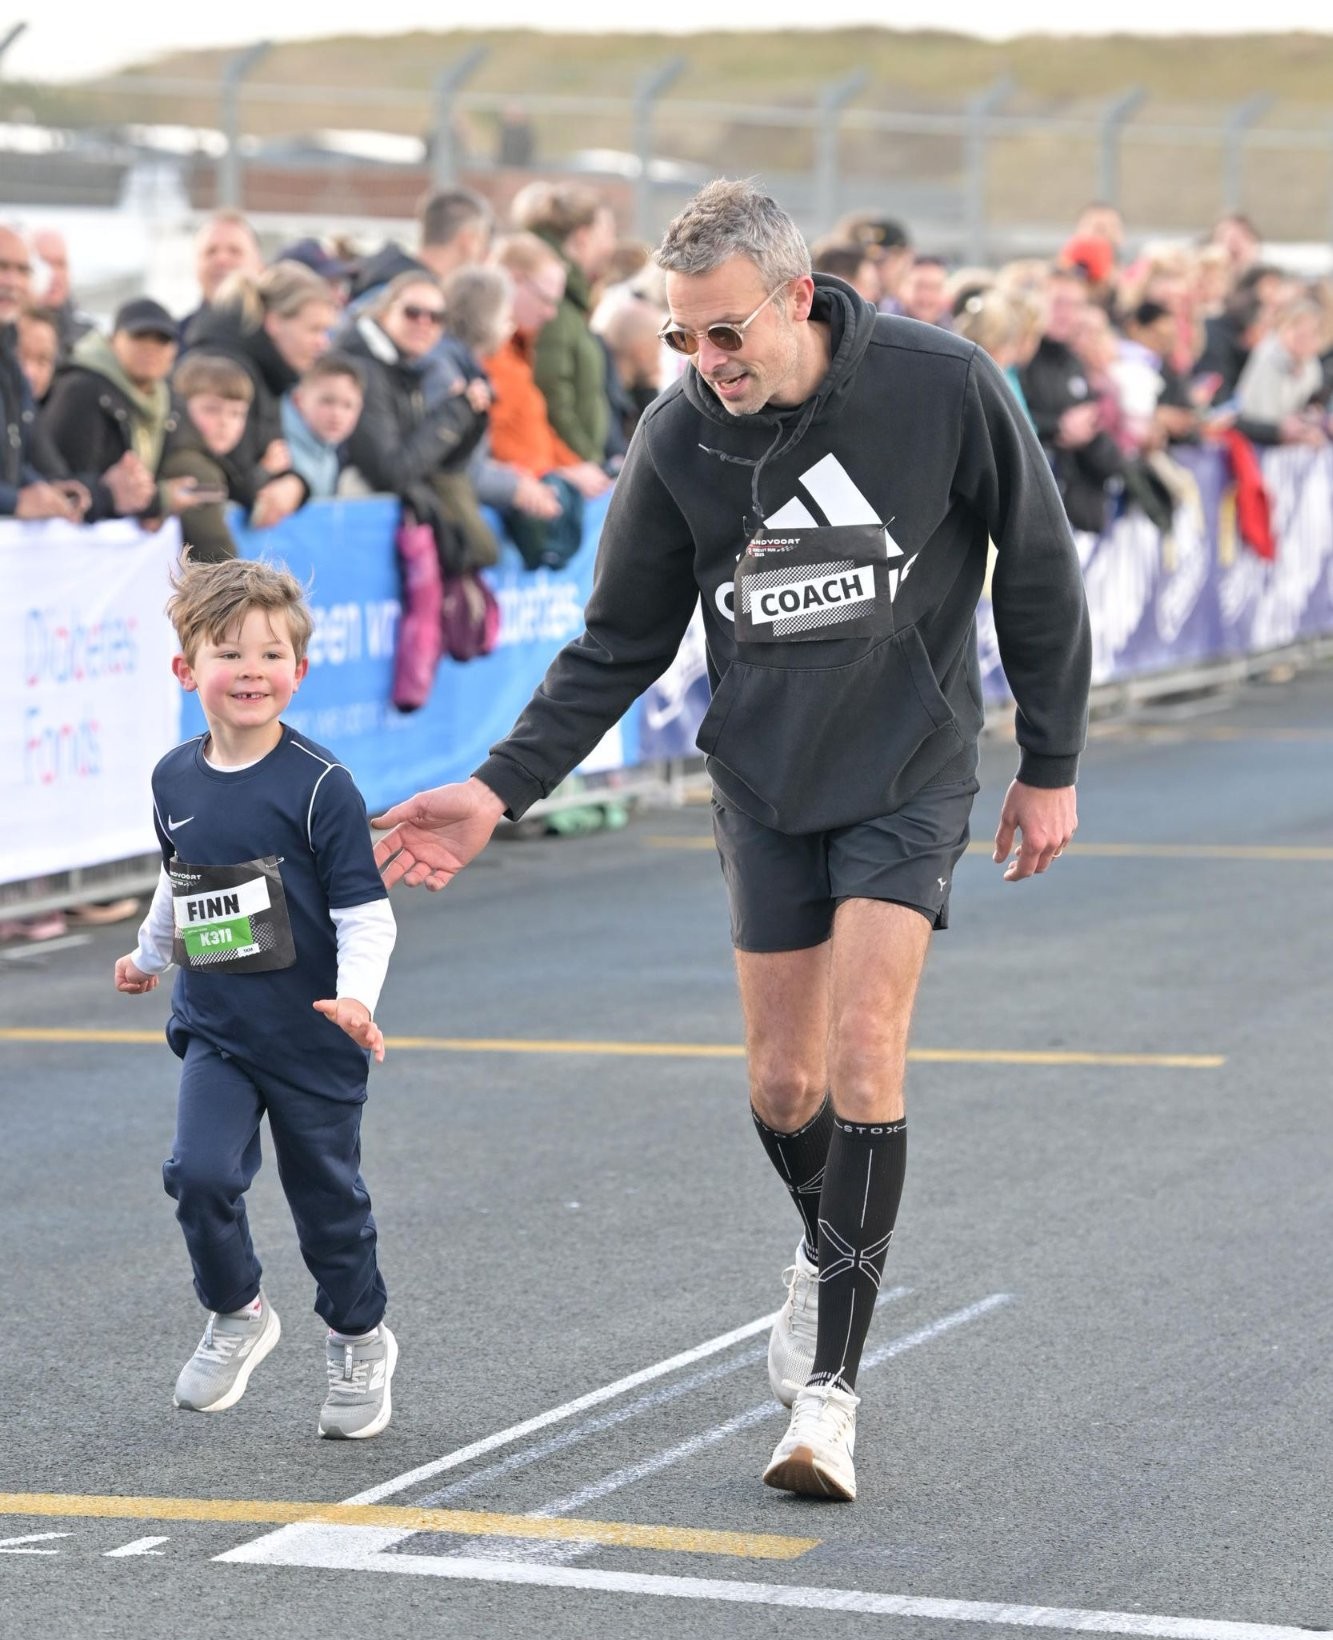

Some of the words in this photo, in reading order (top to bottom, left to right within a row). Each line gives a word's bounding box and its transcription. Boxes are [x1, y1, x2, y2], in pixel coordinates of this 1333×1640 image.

[750, 538, 801, 546] ANDVOORT
[760, 574, 864, 617] COACH
[187, 893, 240, 921] FINN
[200, 928, 233, 947] K311
[842, 1124, 898, 1135] STOX
